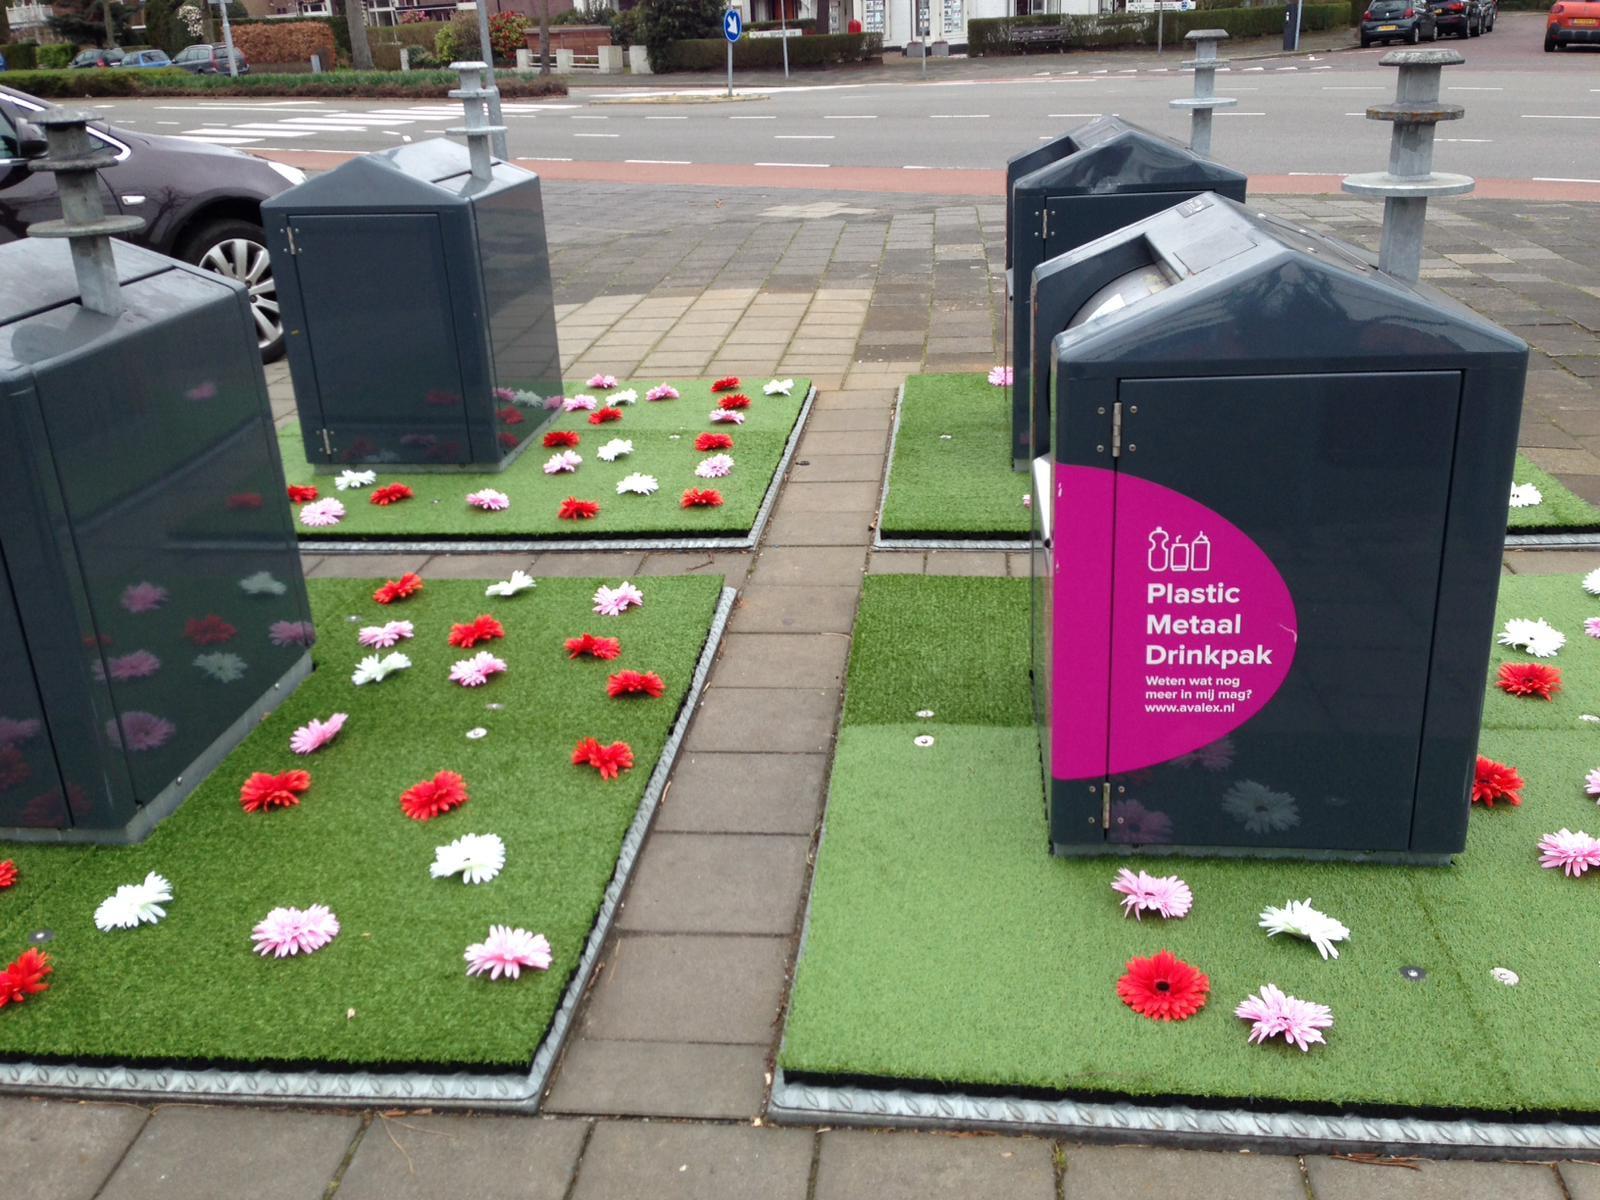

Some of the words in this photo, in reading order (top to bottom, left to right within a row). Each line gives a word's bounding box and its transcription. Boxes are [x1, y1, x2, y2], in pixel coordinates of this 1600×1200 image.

[1148, 583, 1240, 603] Plastic
[1147, 614, 1241, 634] Metaal
[1146, 645, 1272, 669] Drinkpak
[1146, 676, 1185, 685] Weten
[1189, 677, 1212, 685] wat
[1216, 678, 1240, 688] nog
[1181, 689, 1192, 699] in
[1196, 689, 1214, 701] mij
[1218, 690, 1252, 701] mag?
[1145, 703, 1234, 712] www.avalex.nl
